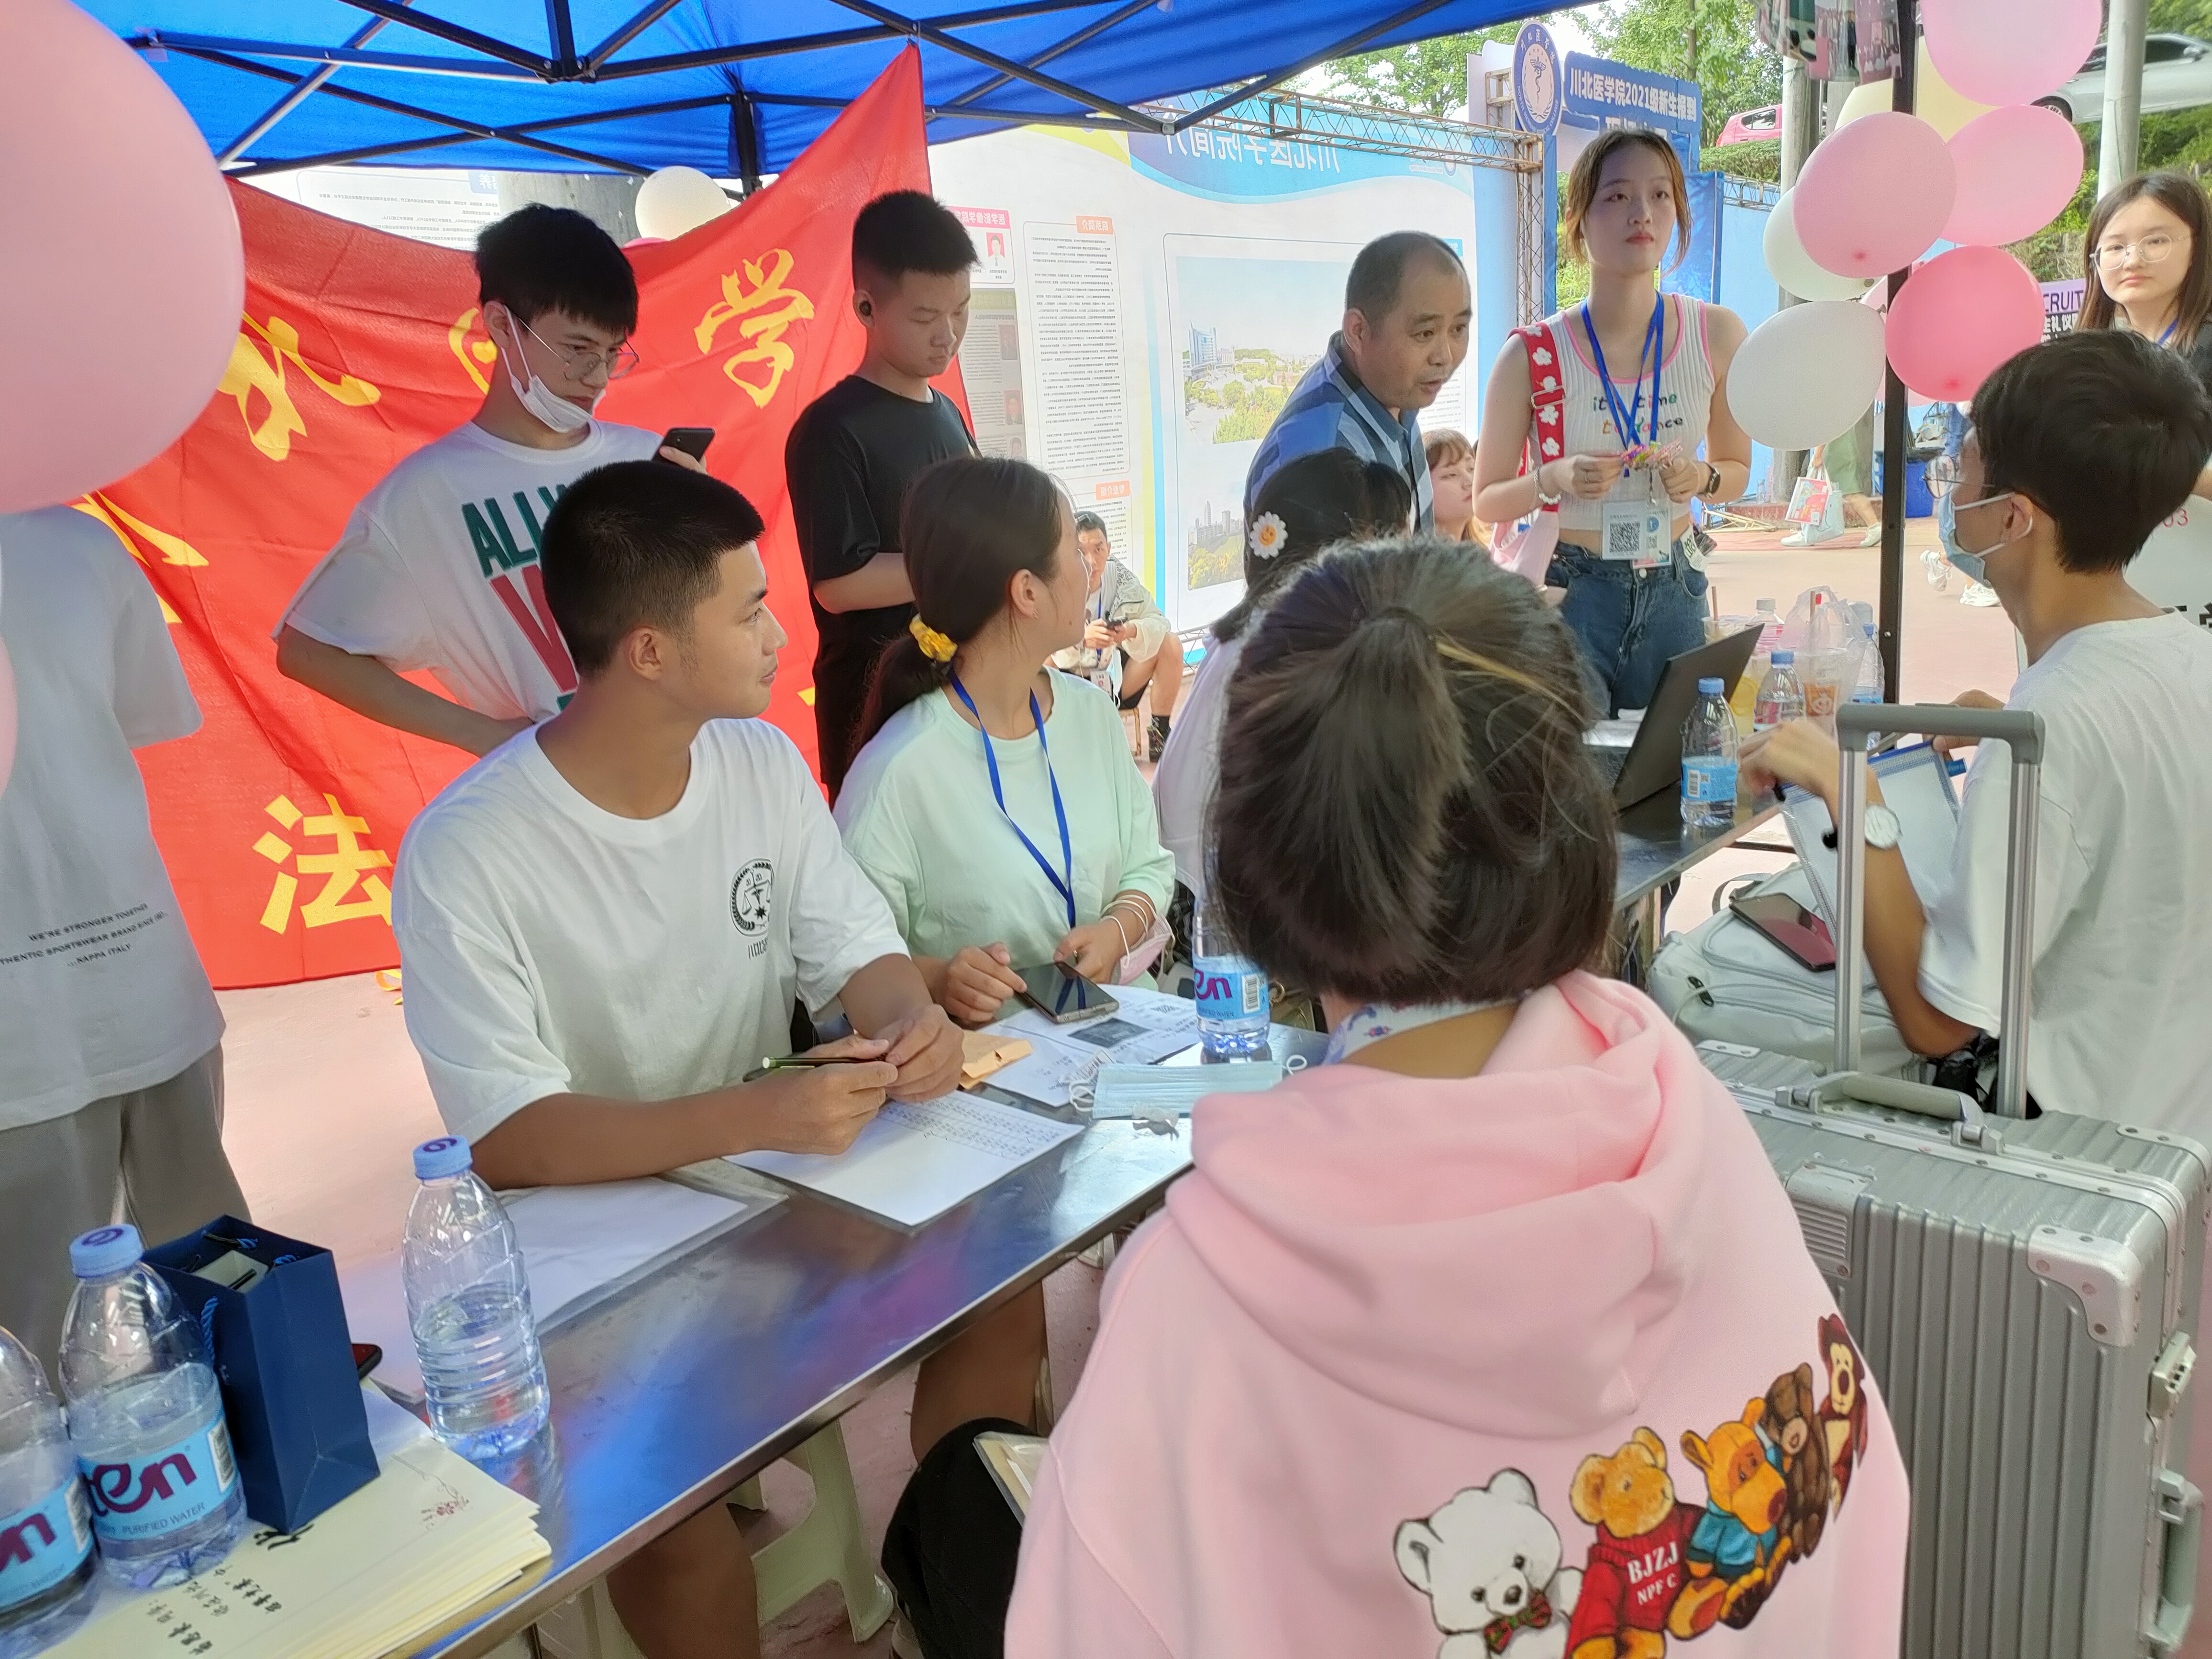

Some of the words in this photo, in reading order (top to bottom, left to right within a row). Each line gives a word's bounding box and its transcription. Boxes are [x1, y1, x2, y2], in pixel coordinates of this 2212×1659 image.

[1570, 67, 1697, 122] 川北医学院2021级新生报到
[252, 793, 393, 934] 法
[169, 1502, 206, 1524] WATER
[1627, 1541, 1679, 1584] BJZJ
